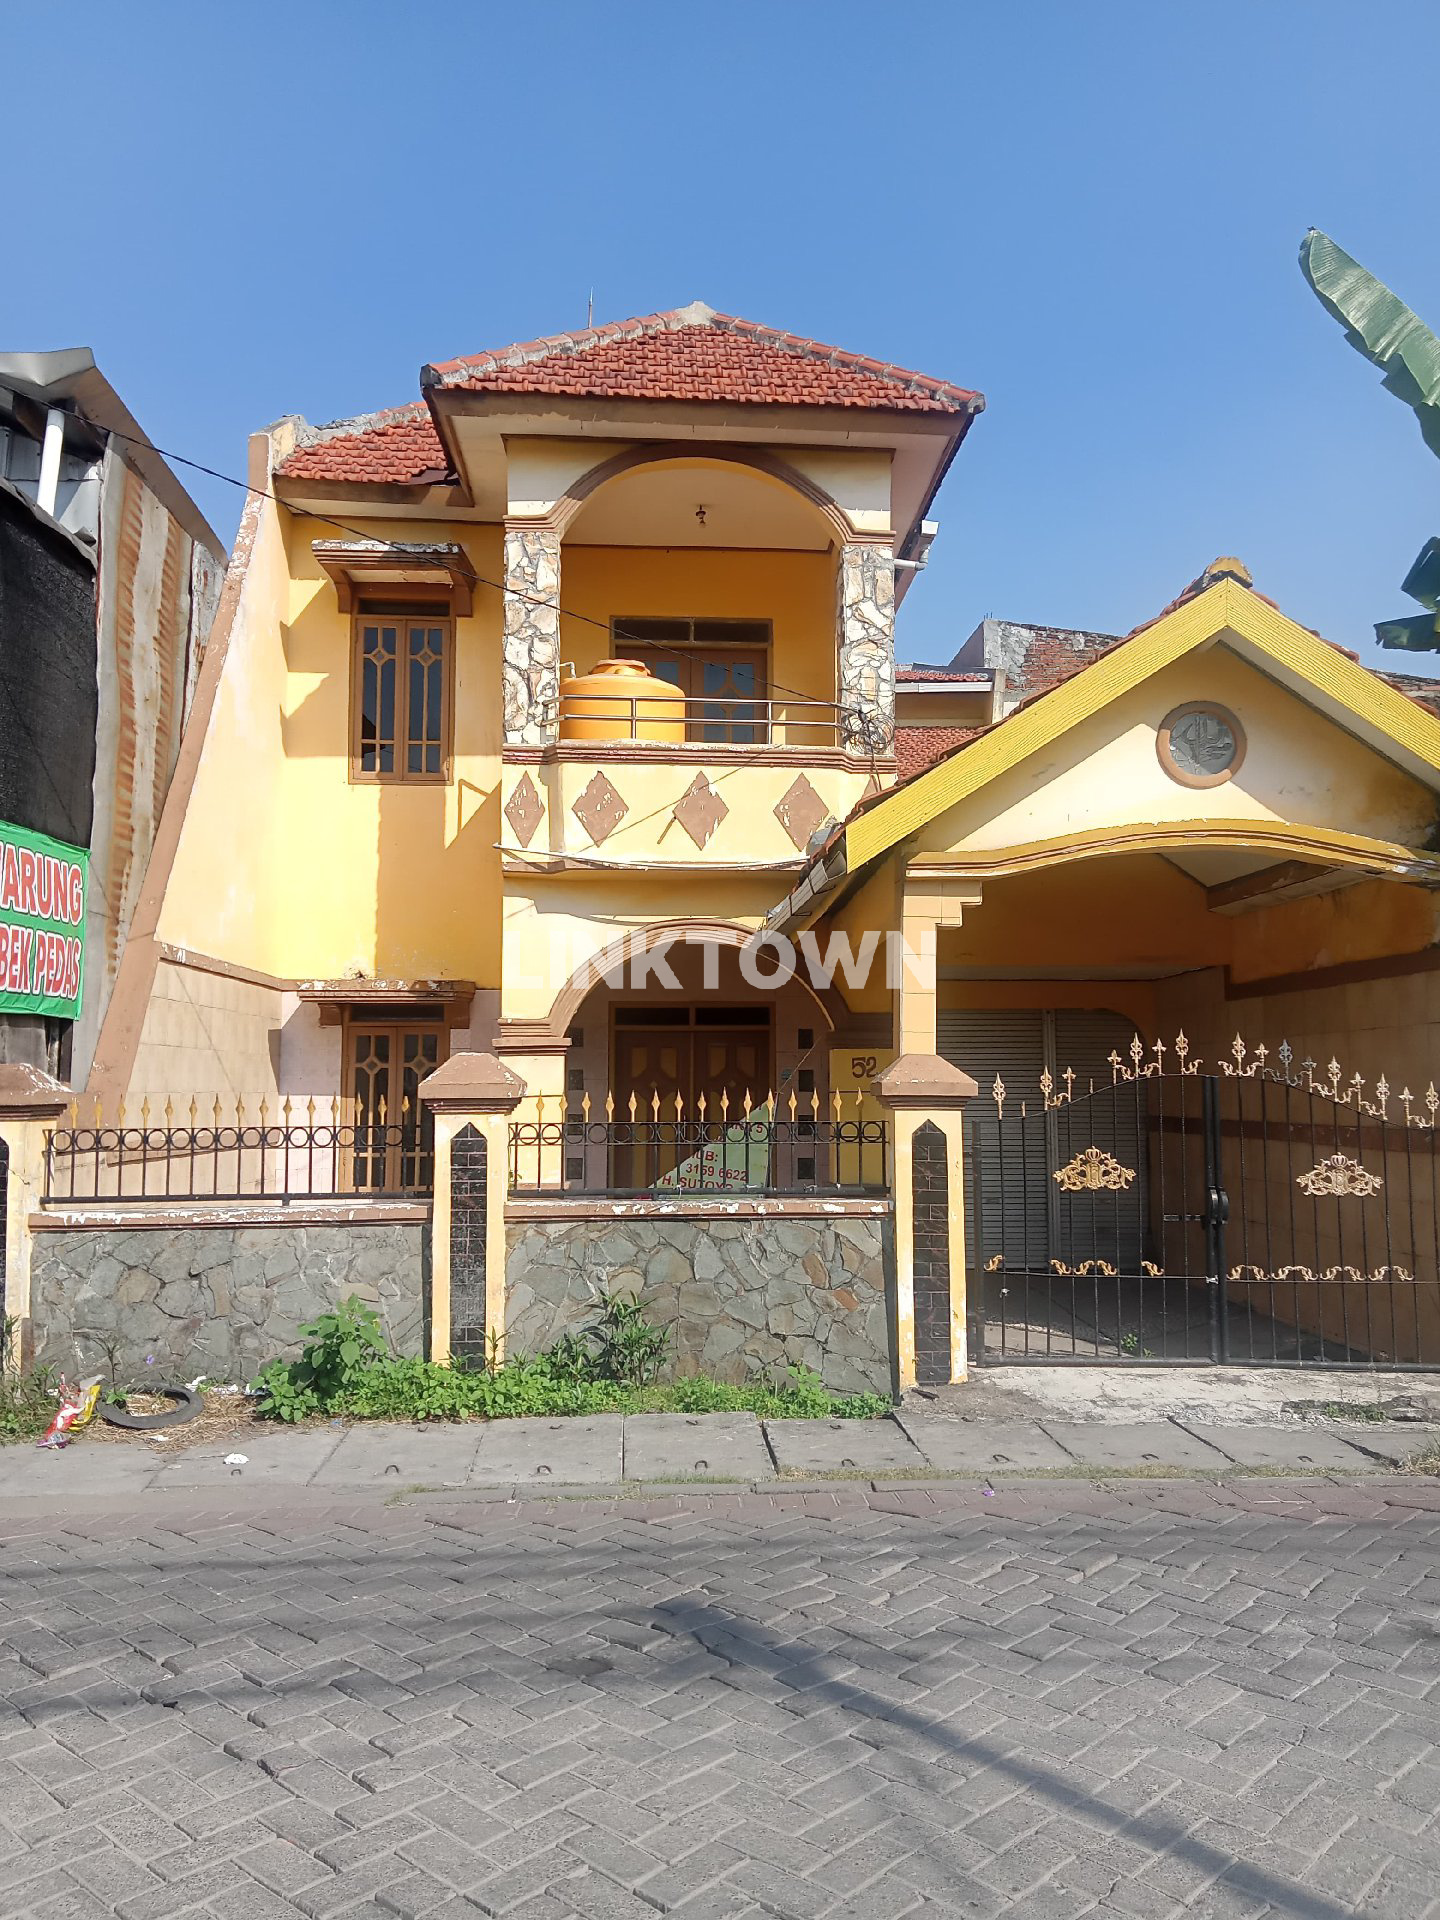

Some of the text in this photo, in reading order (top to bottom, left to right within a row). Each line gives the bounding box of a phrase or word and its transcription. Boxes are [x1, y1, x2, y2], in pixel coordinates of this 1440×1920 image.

[0, 841, 82, 925] ARUNG
[33, 931, 82, 999] PEDAS
[851, 1056, 877, 1078] 52
[691, 1150, 718, 1162] UB:
